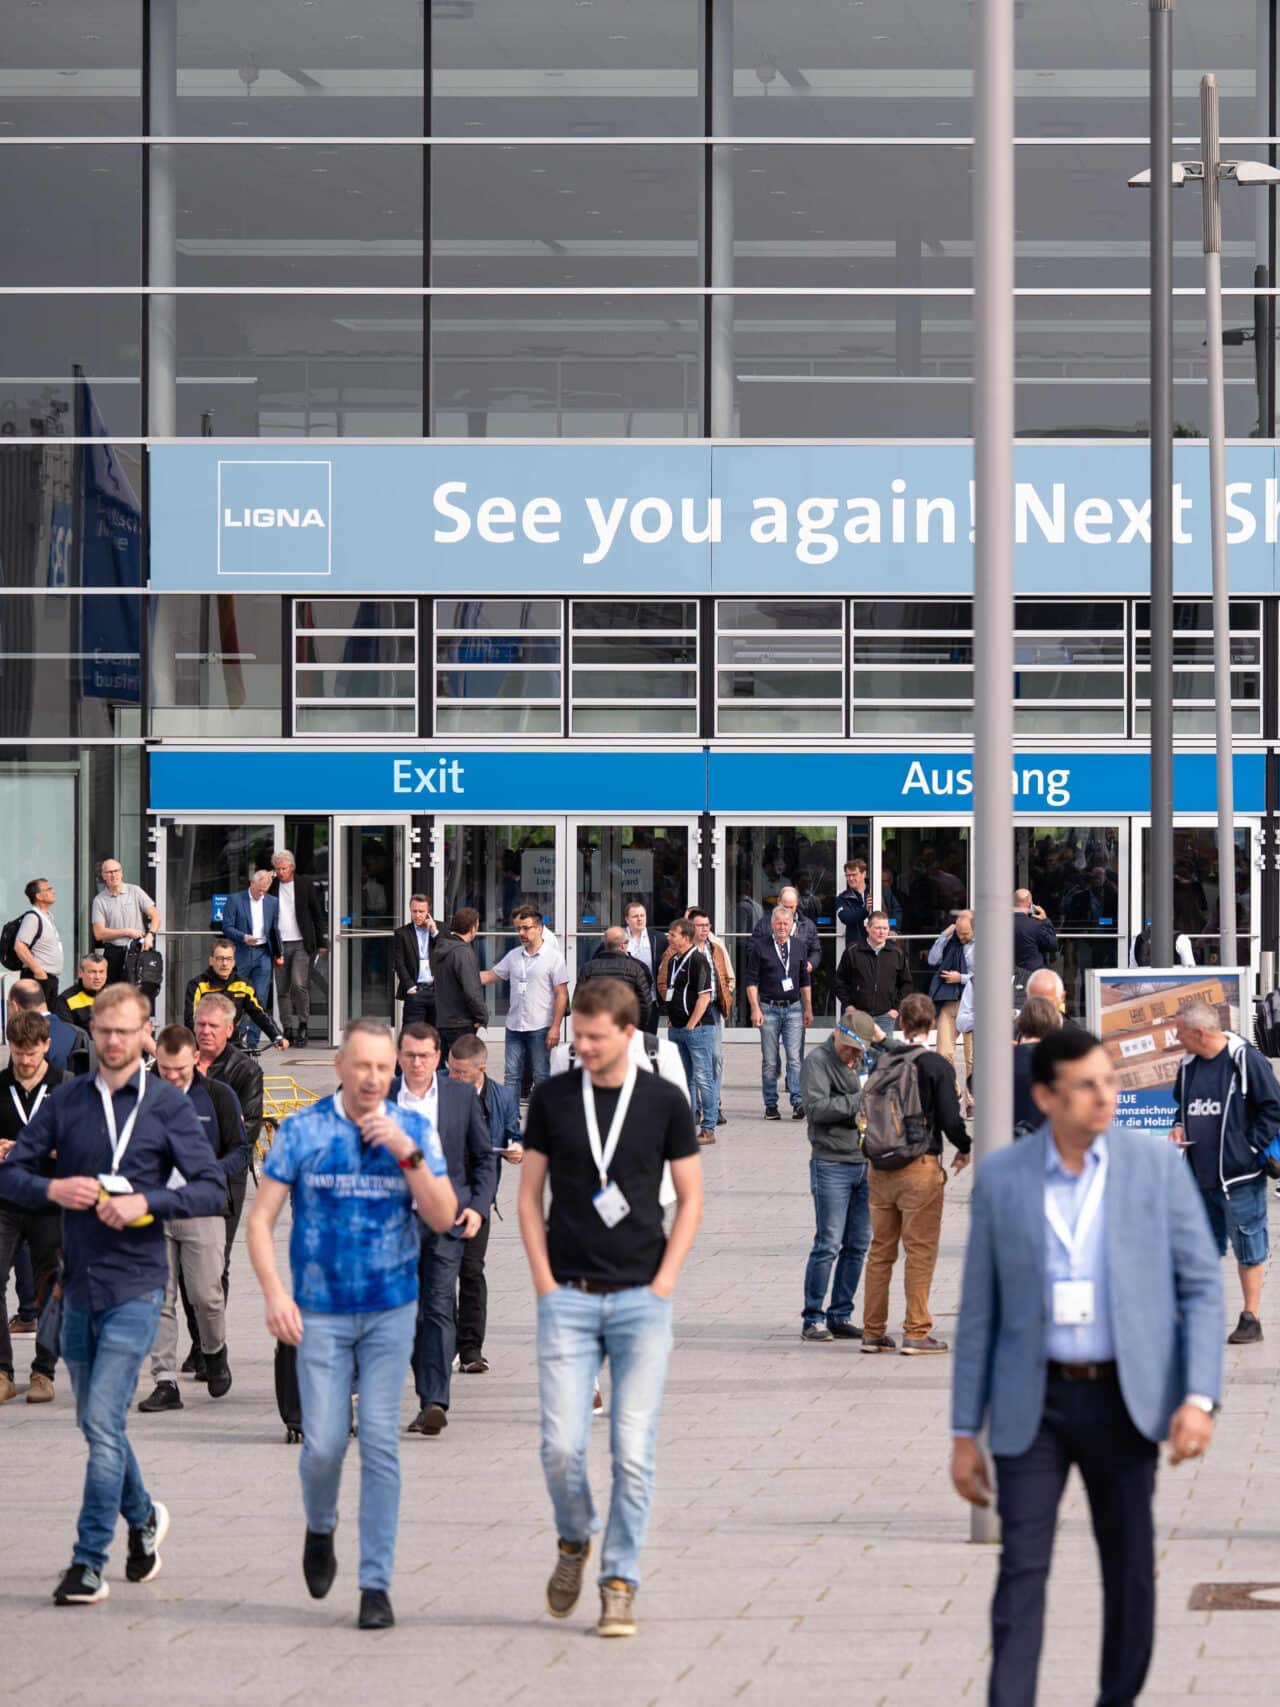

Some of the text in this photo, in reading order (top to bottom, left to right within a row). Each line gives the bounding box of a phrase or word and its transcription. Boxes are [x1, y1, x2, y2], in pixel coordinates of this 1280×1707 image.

[224, 508, 325, 528] LIGNA
[432, 481, 562, 544] See
[582, 496, 722, 564] you
[1014, 482, 1193, 545] Next
[394, 758, 464, 793] Exit
[901, 761, 1070, 807] Ausng
[1116, 1094, 1137, 1104] EUE
[1187, 1098, 1222, 1117] dida
[1115, 1105, 1178, 1115] ennzeichnu
[1144, 1116, 1174, 1126] Holzi
